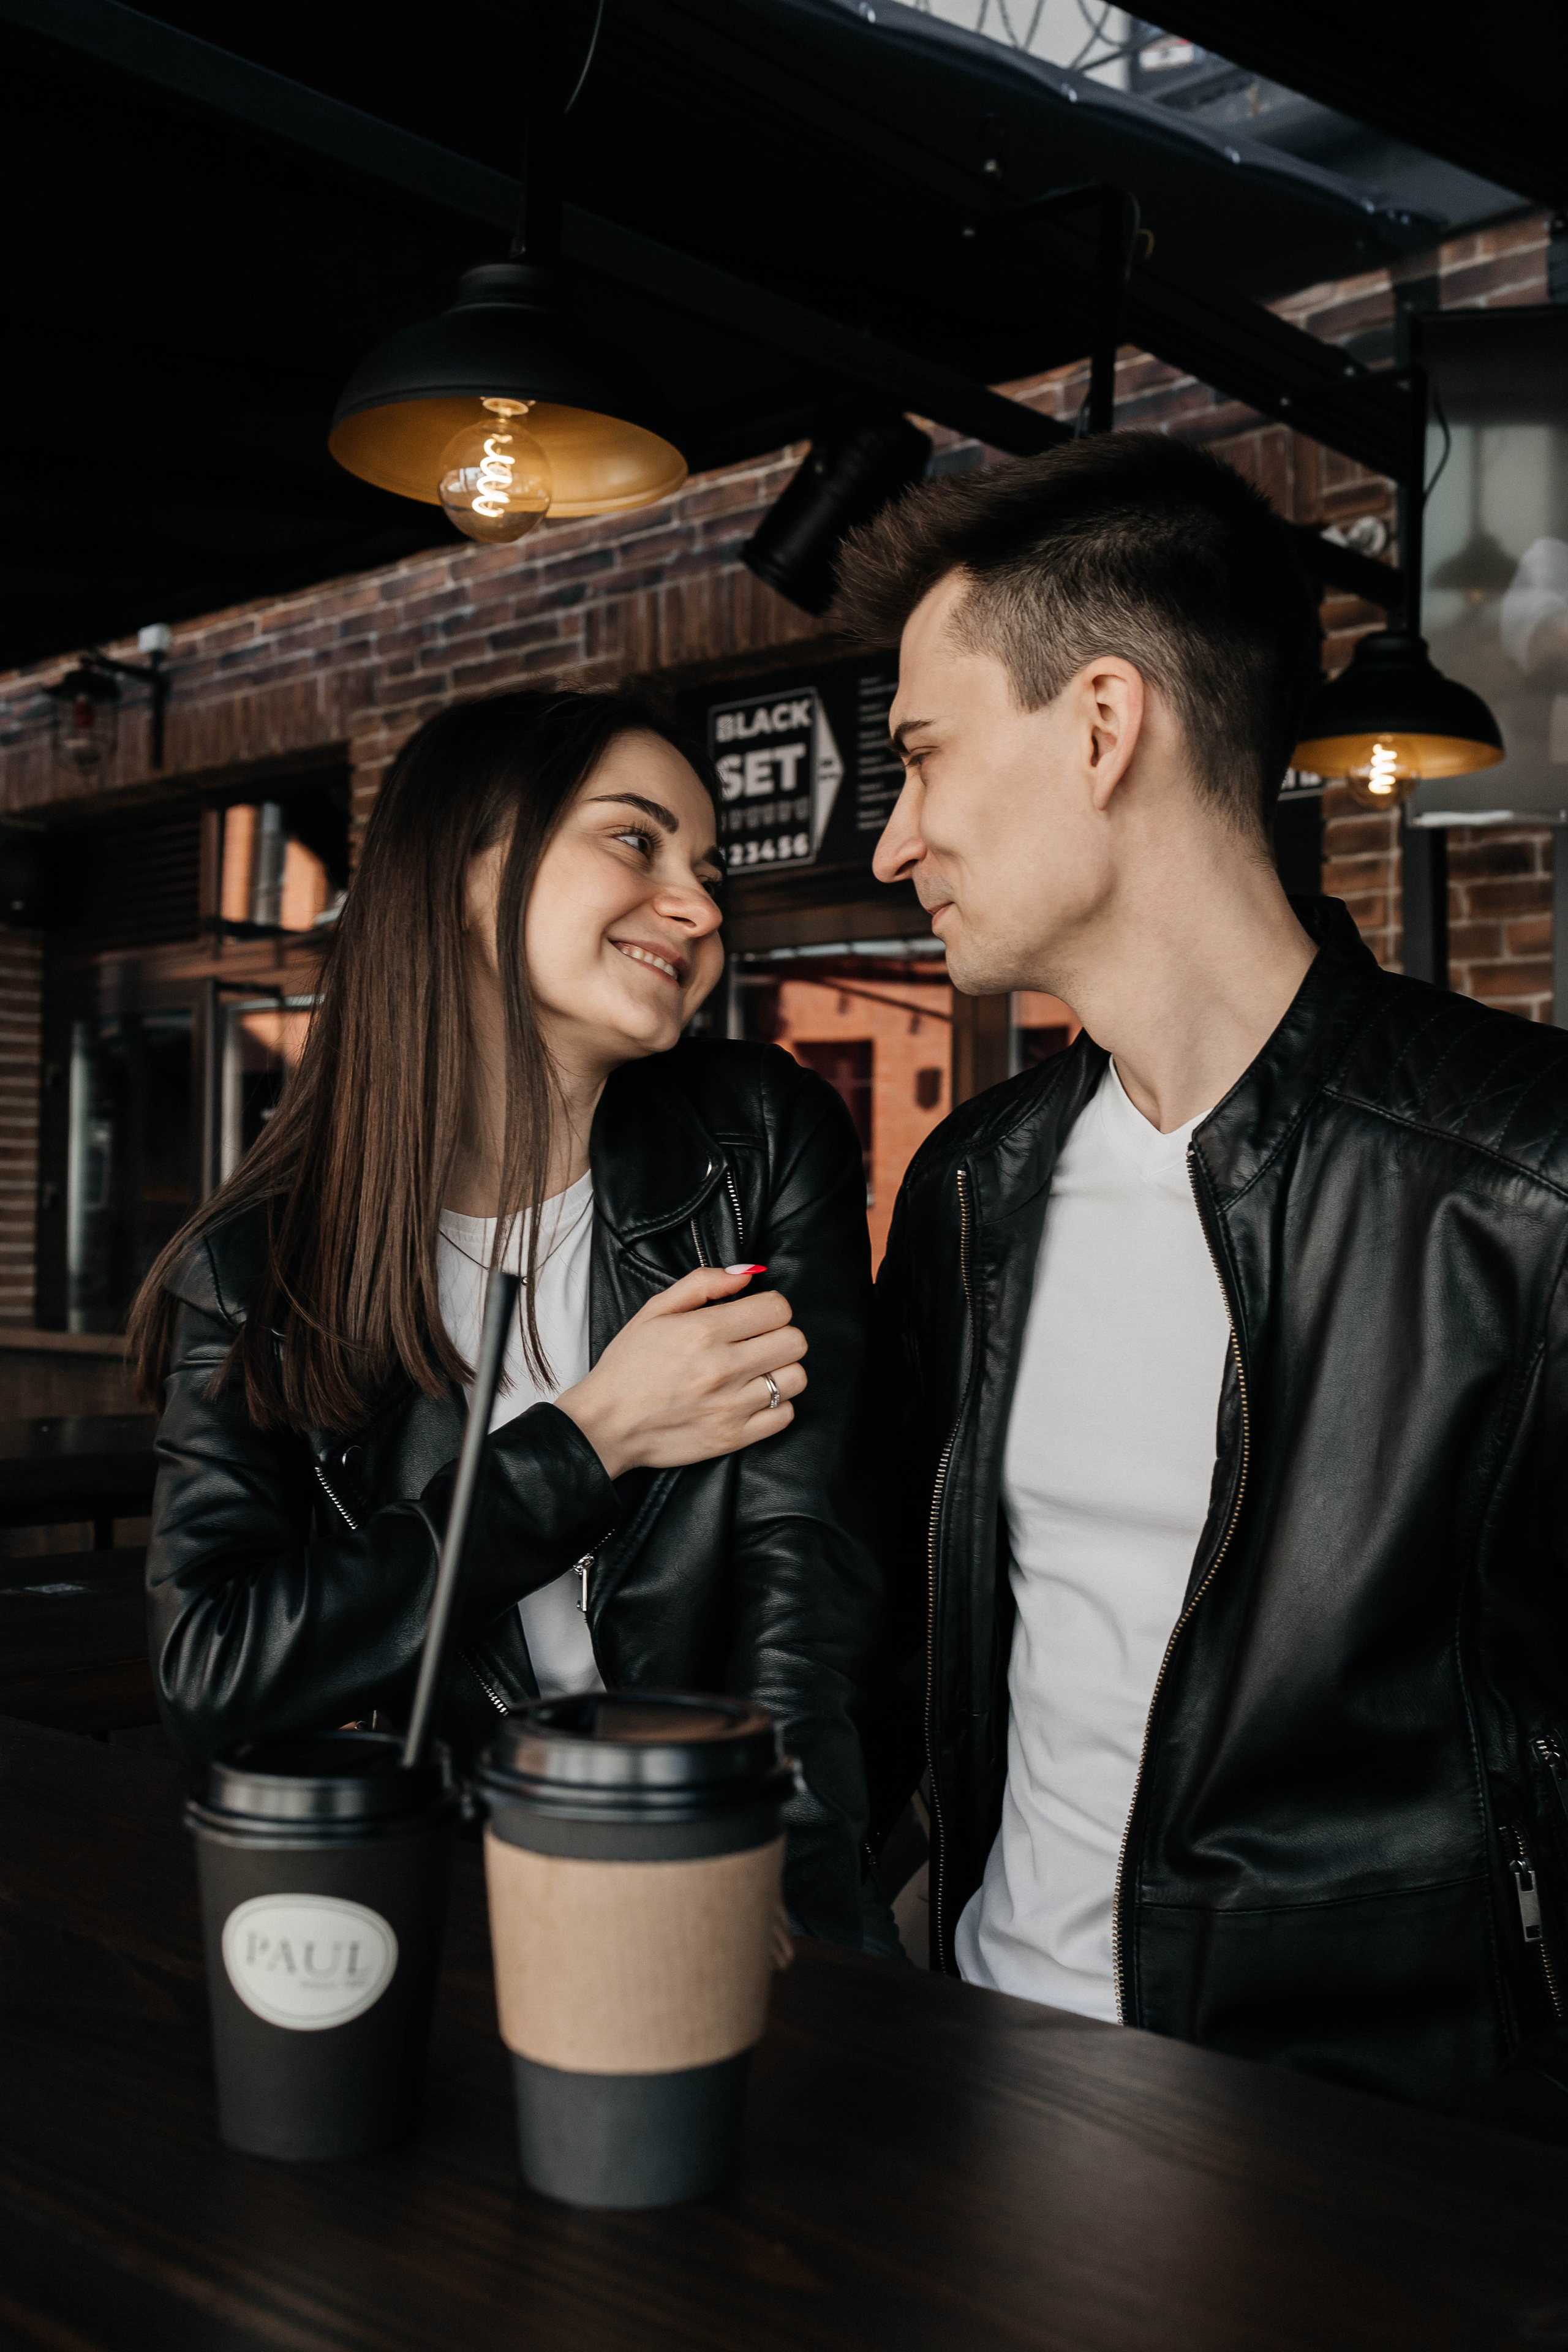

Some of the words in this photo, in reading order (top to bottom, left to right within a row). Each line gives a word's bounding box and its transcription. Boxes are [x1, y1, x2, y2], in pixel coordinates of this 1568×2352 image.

[715, 698, 812, 744] BLACK
[715, 742, 807, 802] SET
[246, 1931, 373, 1977] PAUL
